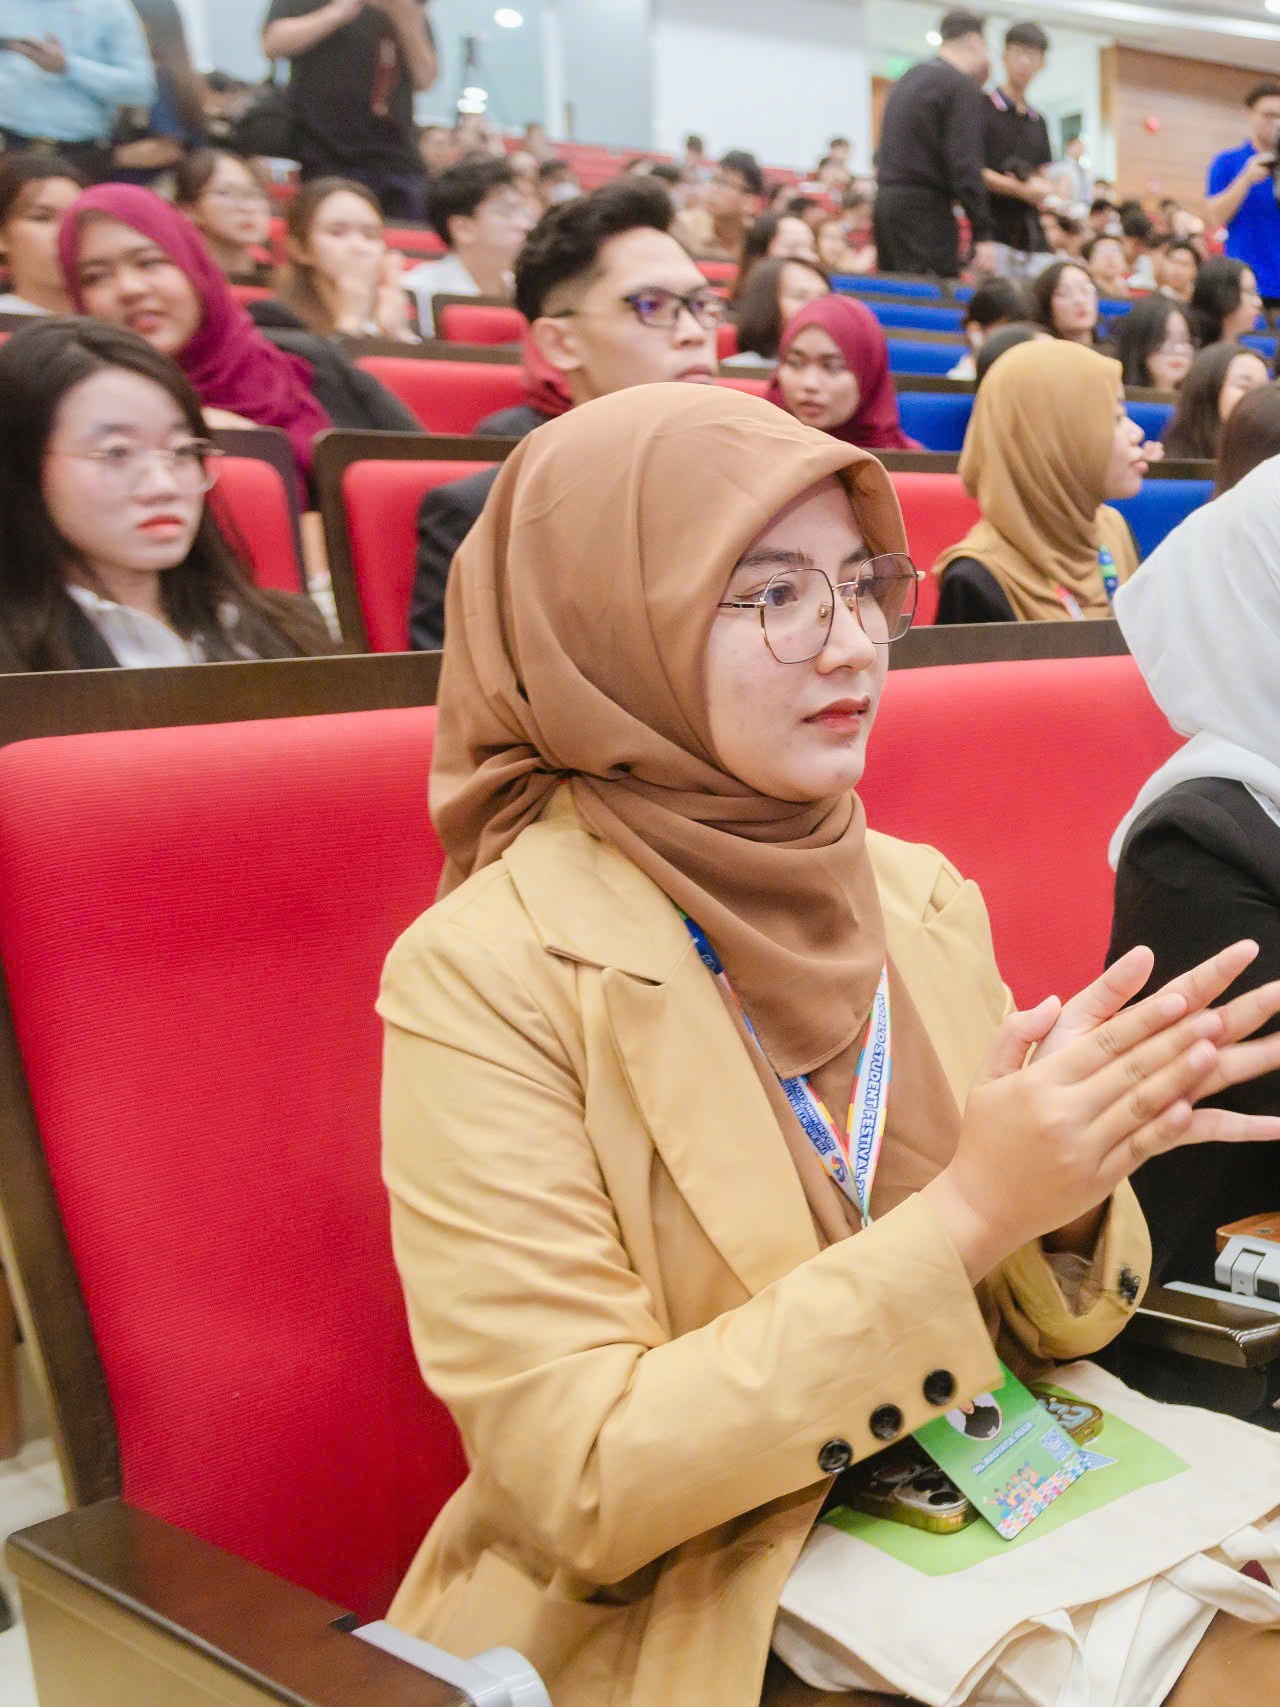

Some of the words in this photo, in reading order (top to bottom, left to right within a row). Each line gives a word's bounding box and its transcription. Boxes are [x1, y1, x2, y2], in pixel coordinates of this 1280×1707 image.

[875, 992, 885, 1043] WORLD
[865, 1043, 884, 1108] STUDENT
[802, 1100, 821, 1126] MINH
[854, 1109, 875, 1178] FESTIVAL
